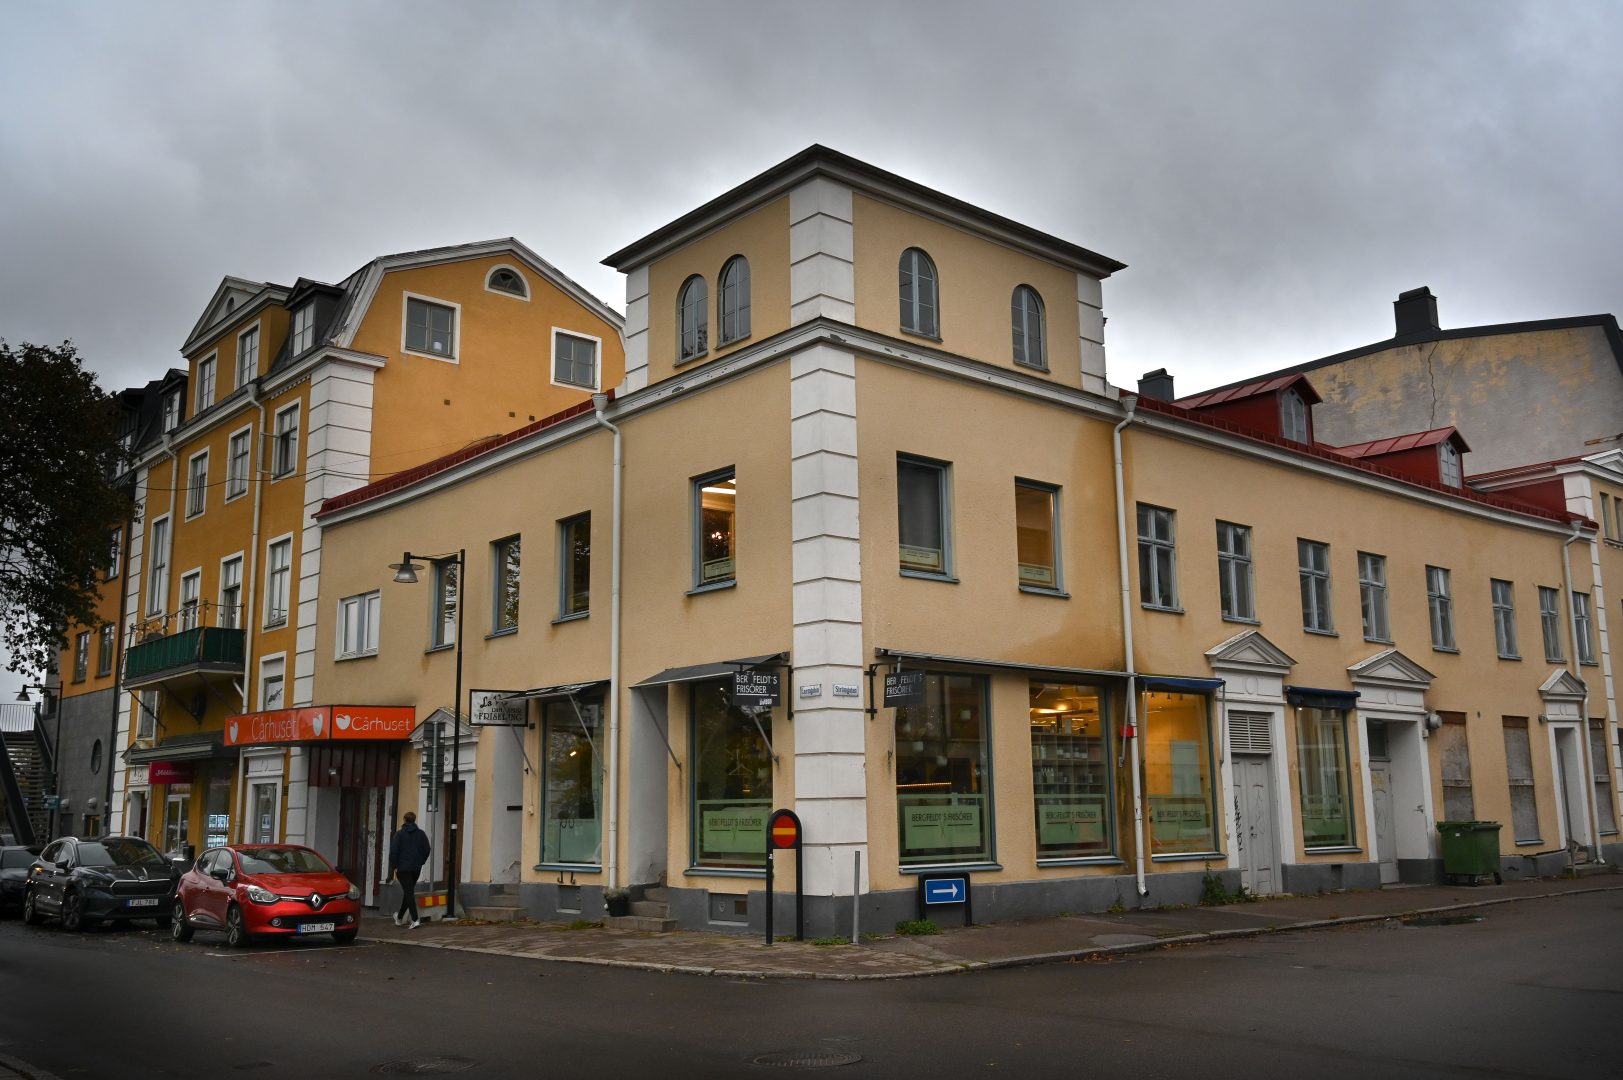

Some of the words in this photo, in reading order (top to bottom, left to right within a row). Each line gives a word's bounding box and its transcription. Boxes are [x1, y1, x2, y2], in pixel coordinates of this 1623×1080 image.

[736, 683, 767, 694] FRISÖRER
[251, 715, 297, 741] Cårhuset
[351, 716, 411, 731] Cårhuset
